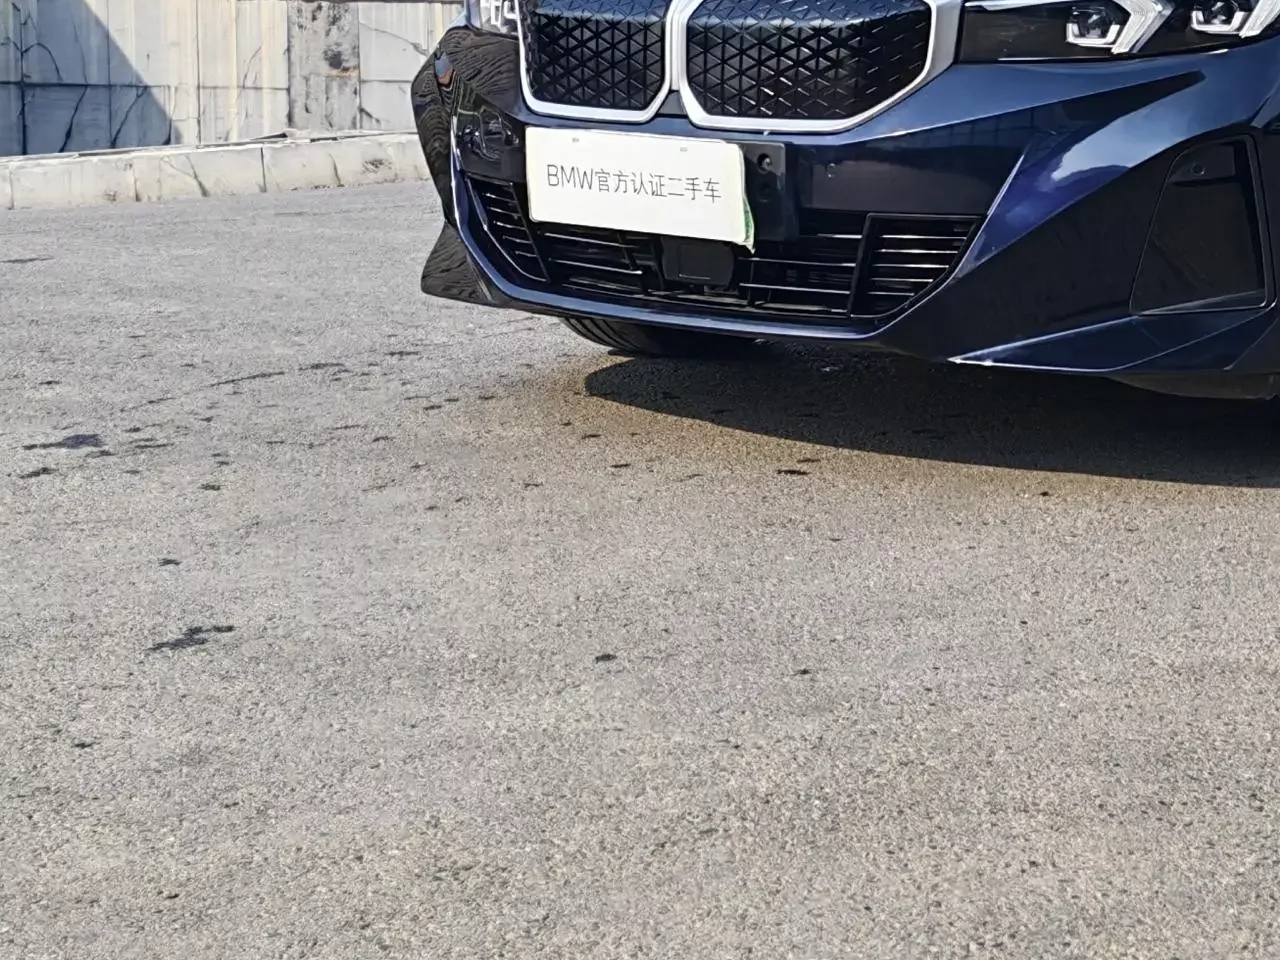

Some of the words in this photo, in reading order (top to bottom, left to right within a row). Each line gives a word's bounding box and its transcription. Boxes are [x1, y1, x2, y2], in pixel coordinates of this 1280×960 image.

[546, 164, 722, 203] BMW官方认证二手车
